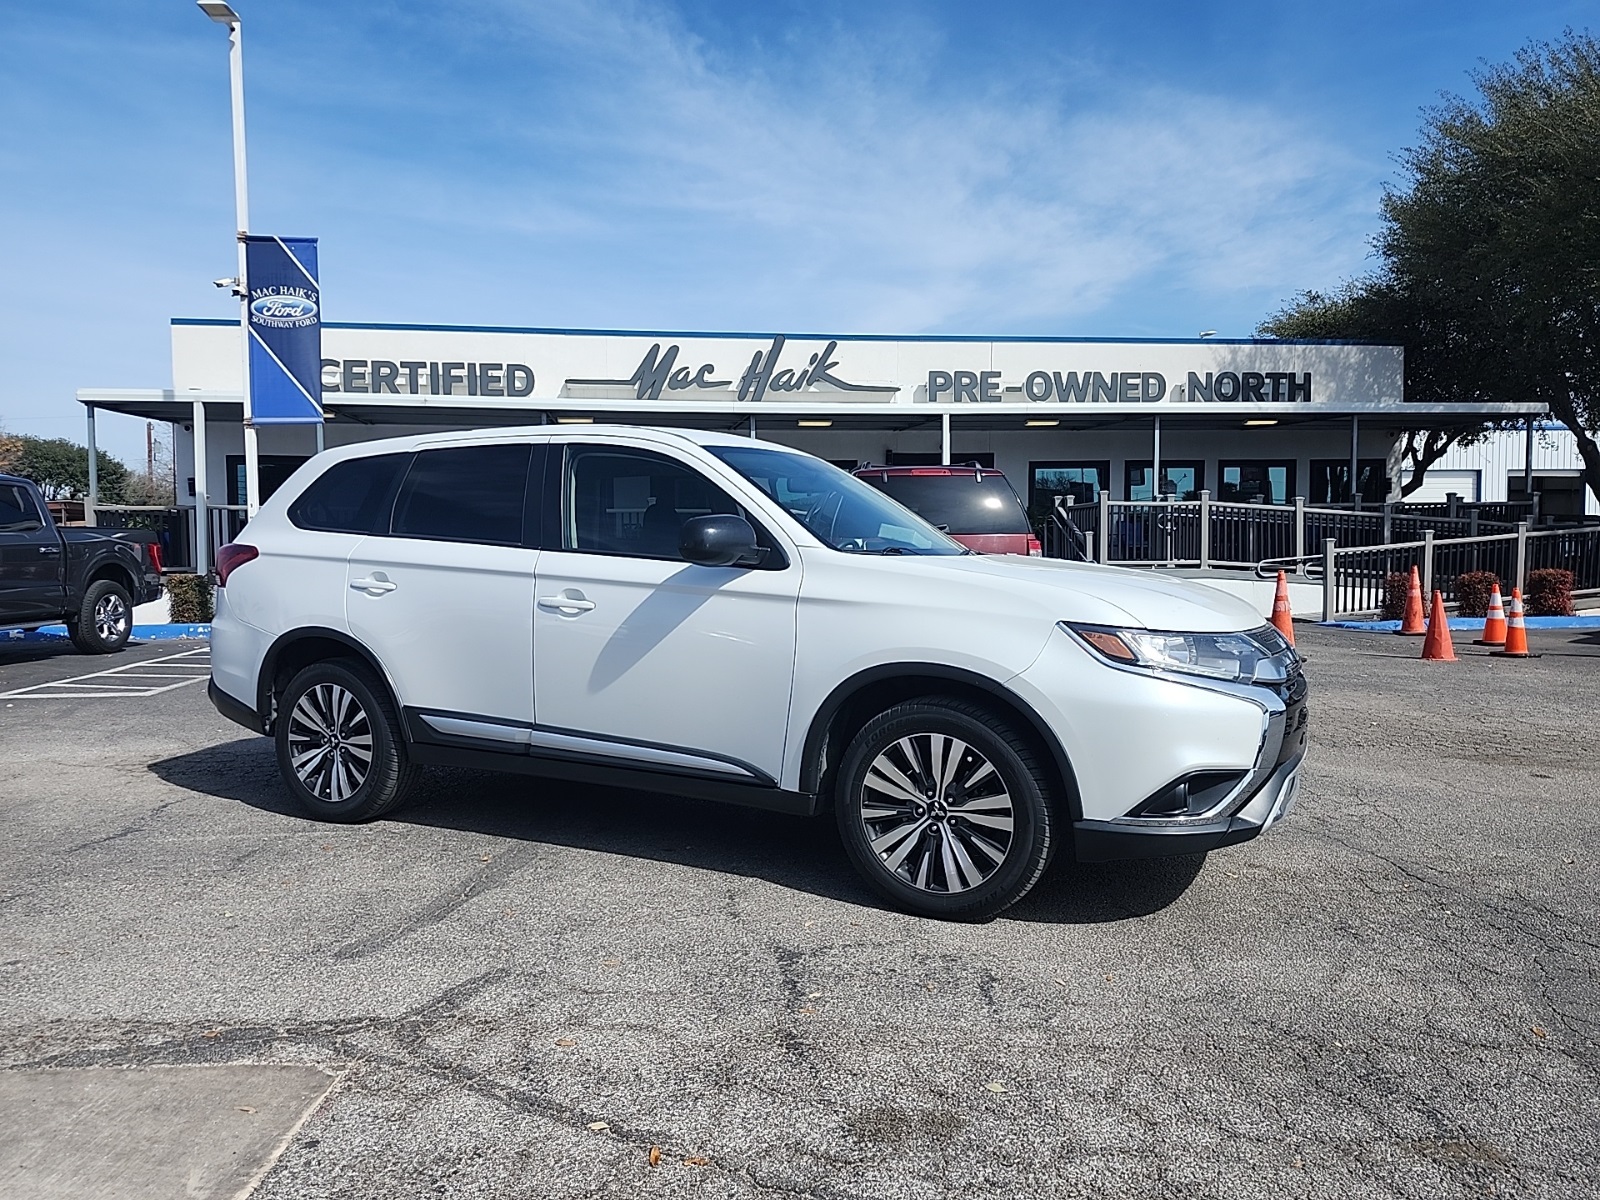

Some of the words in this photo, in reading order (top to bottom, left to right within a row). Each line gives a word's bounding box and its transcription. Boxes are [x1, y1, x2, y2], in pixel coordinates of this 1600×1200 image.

[251, 286, 277, 299] MAC
[280, 286, 318, 302] HAIK'S
[262, 299, 305, 317] Ford
[251, 315, 294, 329] SOUTHWAY
[296, 316, 318, 328] FORD
[321, 359, 535, 398] CERTIFIED
[628, 343, 733, 401] Mac
[737, 334, 855, 402] Haik
[928, 370, 1167, 404] PRE-OWNED
[1187, 371, 1312, 404] NORTH
